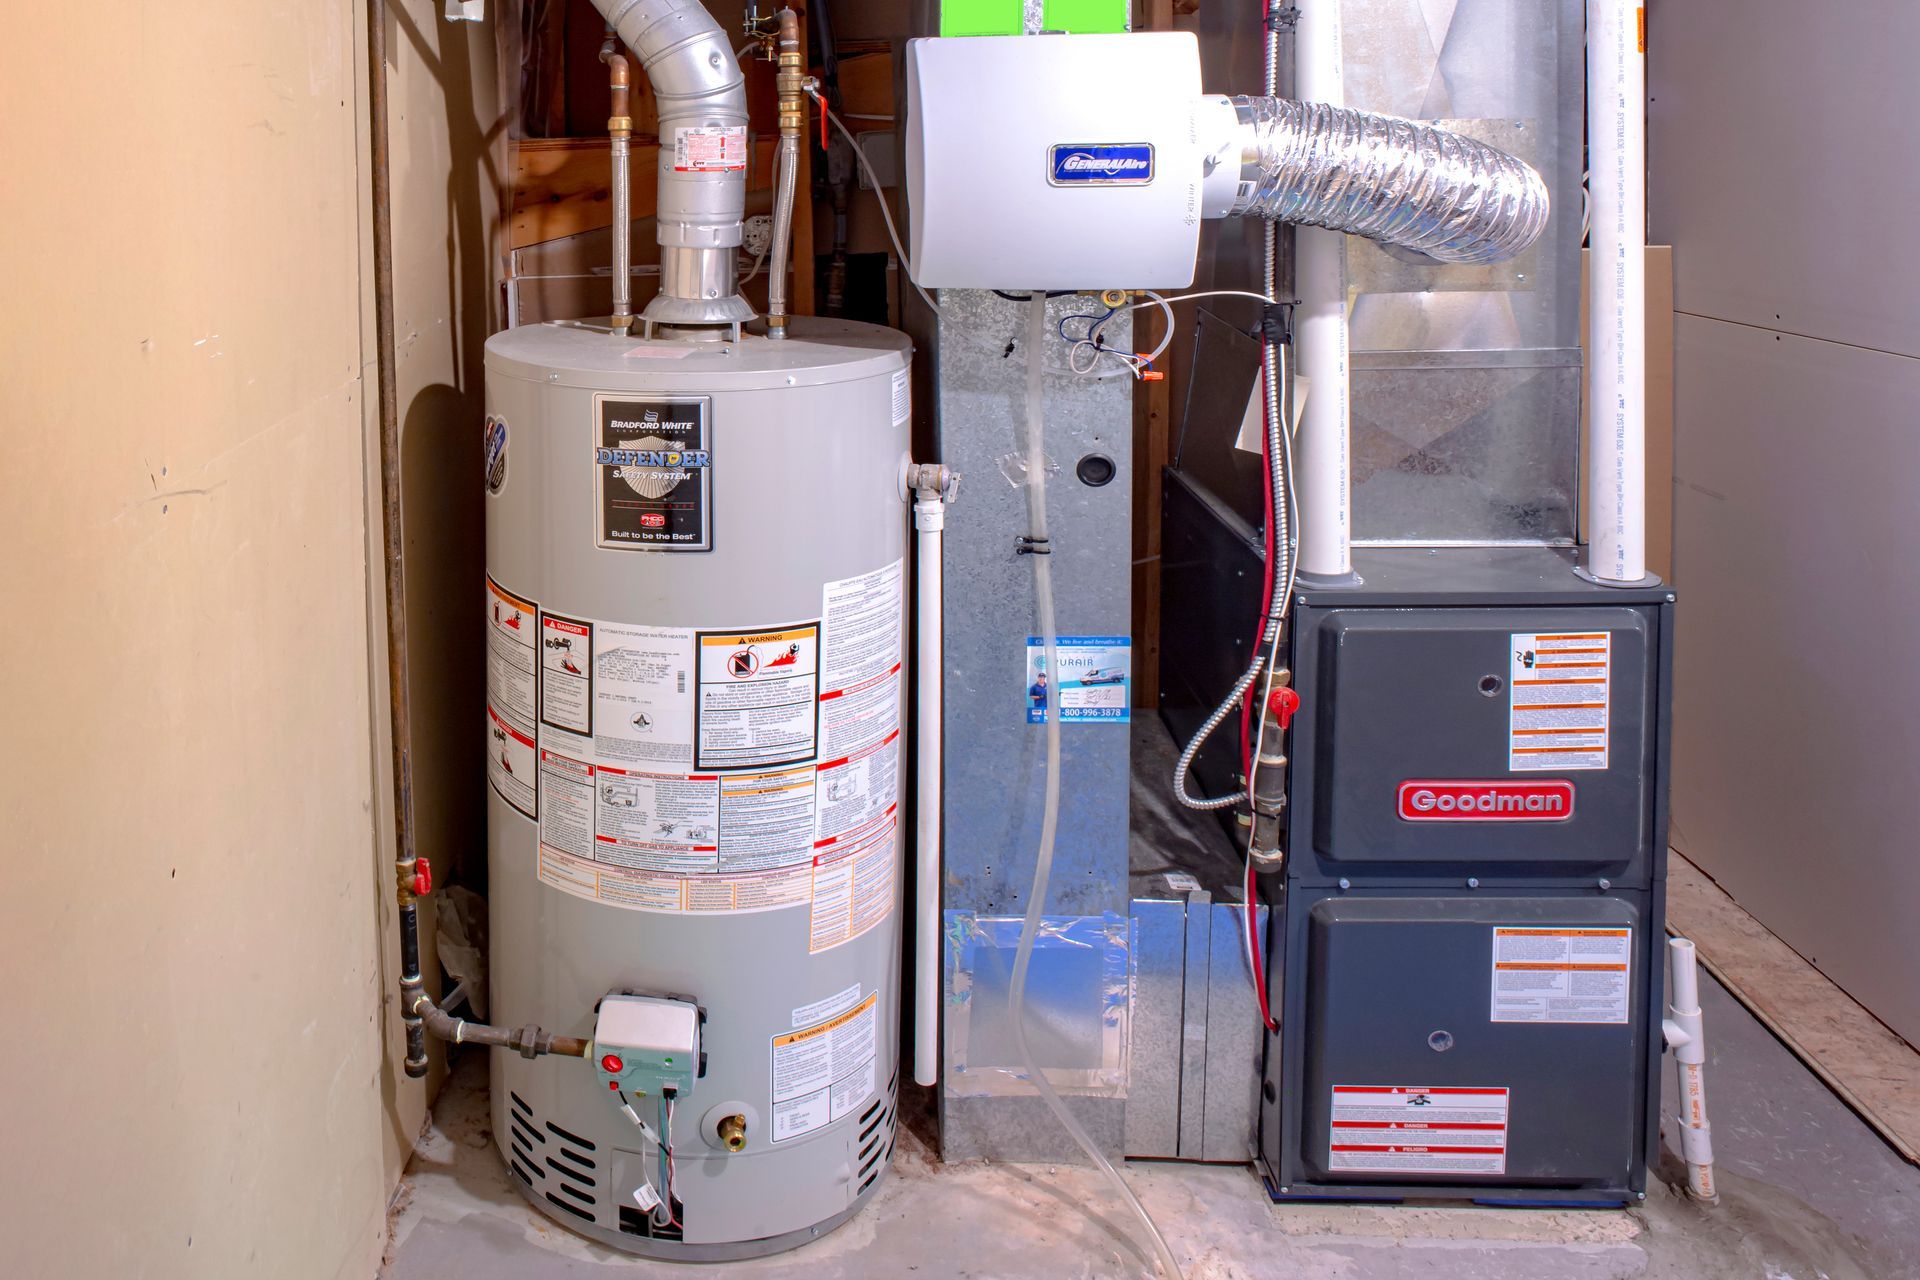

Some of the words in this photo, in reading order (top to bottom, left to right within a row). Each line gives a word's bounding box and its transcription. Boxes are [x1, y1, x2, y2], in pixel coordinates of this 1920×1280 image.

[611, 420, 659, 429] BRADFORD
[662, 422, 692, 430] WHITE
[597, 448, 710, 467] DEFENDER
[612, 470, 648, 479] SAFETY
[651, 471, 691, 480] SYSTEM
[557, 622, 582, 634] DANGER
[748, 635, 782, 643] WARNING
[1411, 790, 1562, 811] Goodman
[798, 1027, 825, 1040] WARNING
[829, 1004, 866, 1029] AVERTISSEMENT
